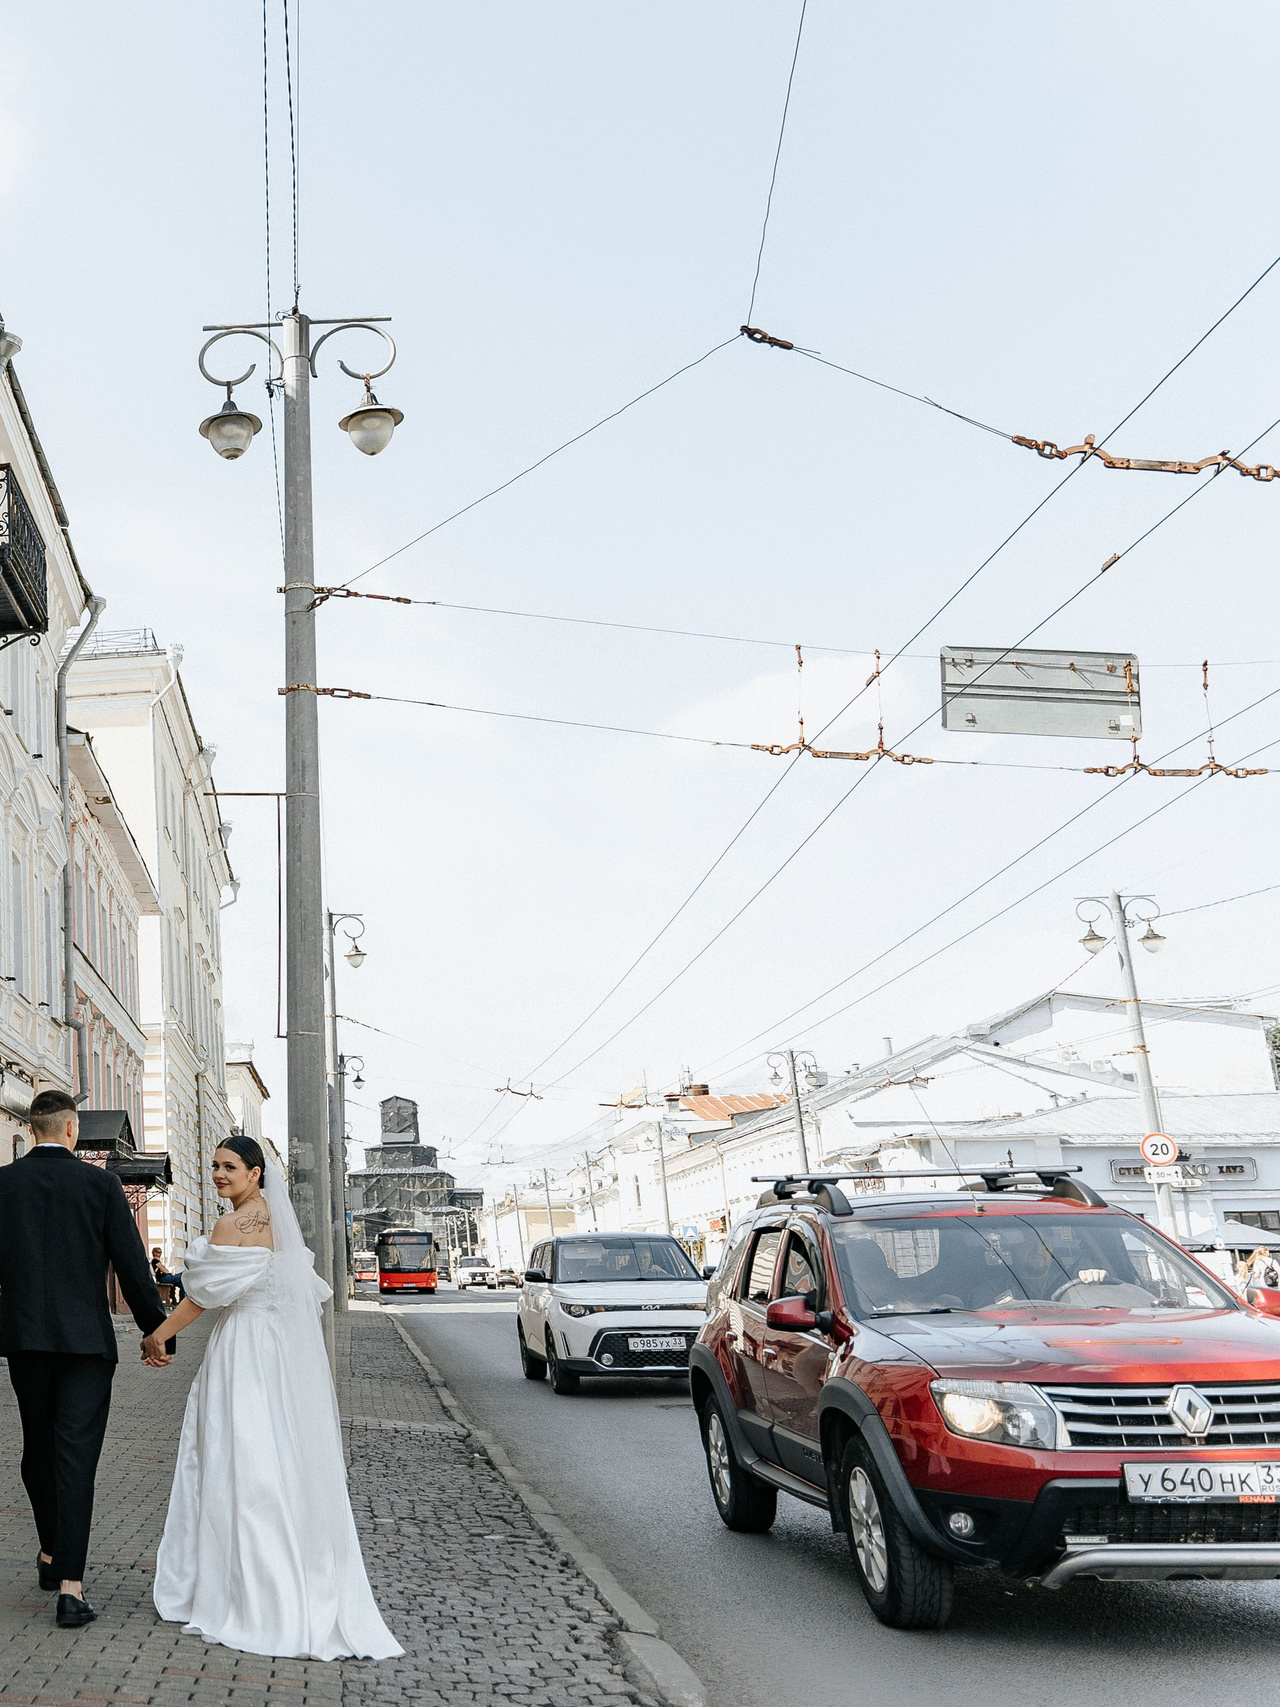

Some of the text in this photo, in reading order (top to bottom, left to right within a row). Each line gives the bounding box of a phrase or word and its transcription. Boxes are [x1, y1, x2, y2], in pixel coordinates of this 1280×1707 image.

[1150, 1143, 1170, 1156] 20
[1118, 1165, 1145, 1176] СТЕЙ
[1217, 1164, 1245, 1175] ХАУЗ
[1238, 1495, 1276, 1503] RENAULT
